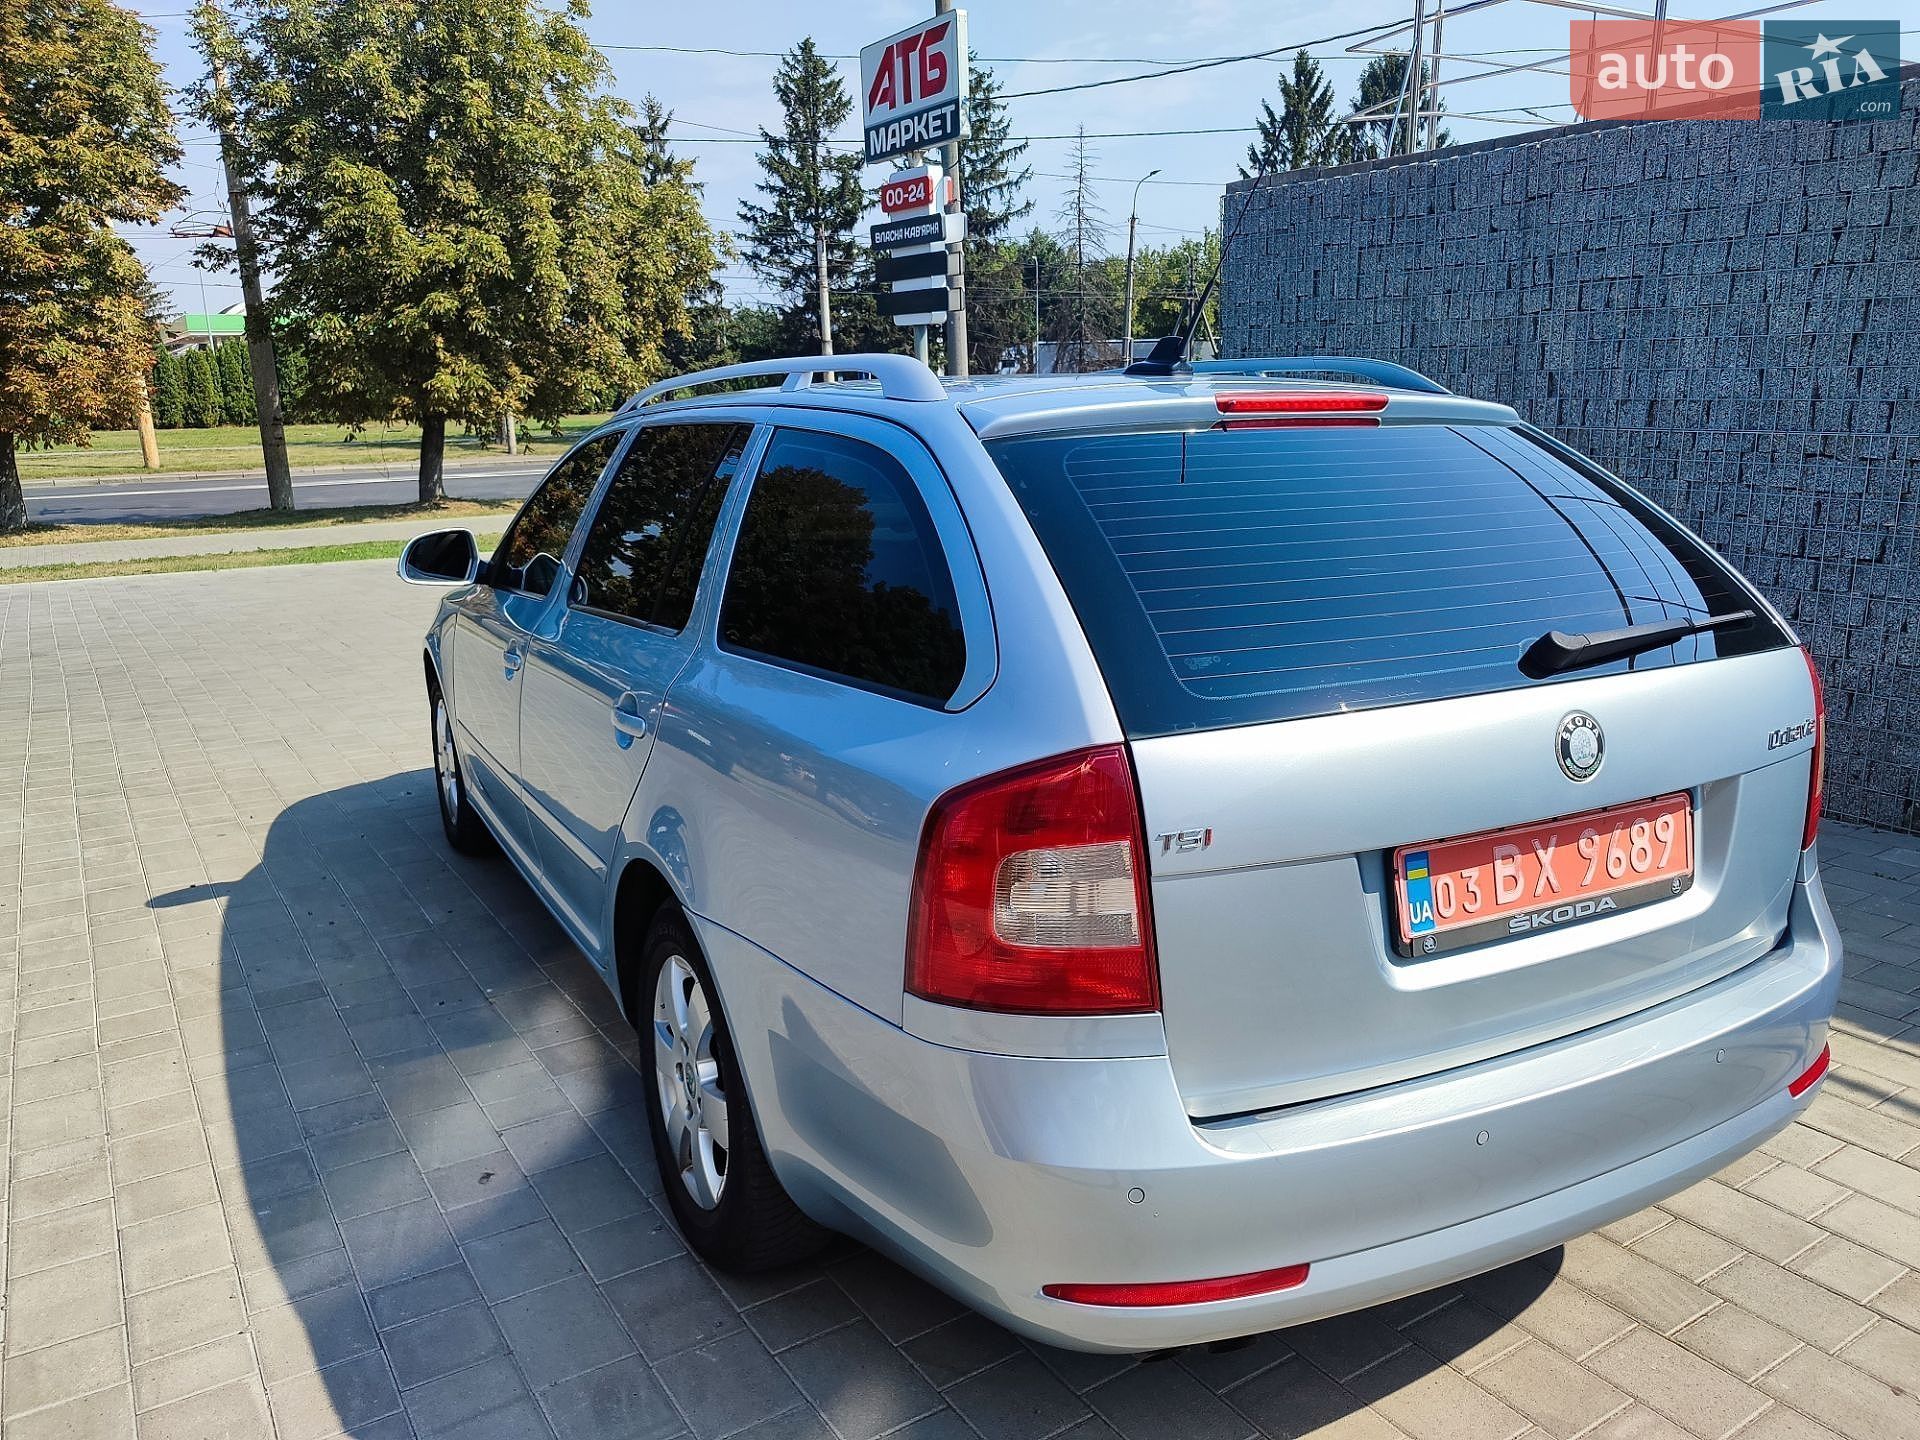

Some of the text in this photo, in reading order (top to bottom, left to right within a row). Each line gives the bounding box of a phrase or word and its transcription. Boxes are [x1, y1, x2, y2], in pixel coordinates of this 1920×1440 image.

[868, 20, 951, 116] АТБ
[869, 104, 956, 156] МАРКЕТ
[886, 182, 925, 207] 00-24
[1153, 827, 1213, 855] TSI
[1435, 869, 1483, 919] 03
[1577, 812, 1675, 887] 9689
[1409, 901, 1434, 926] UA
[1508, 896, 1617, 934] ŠKODA
